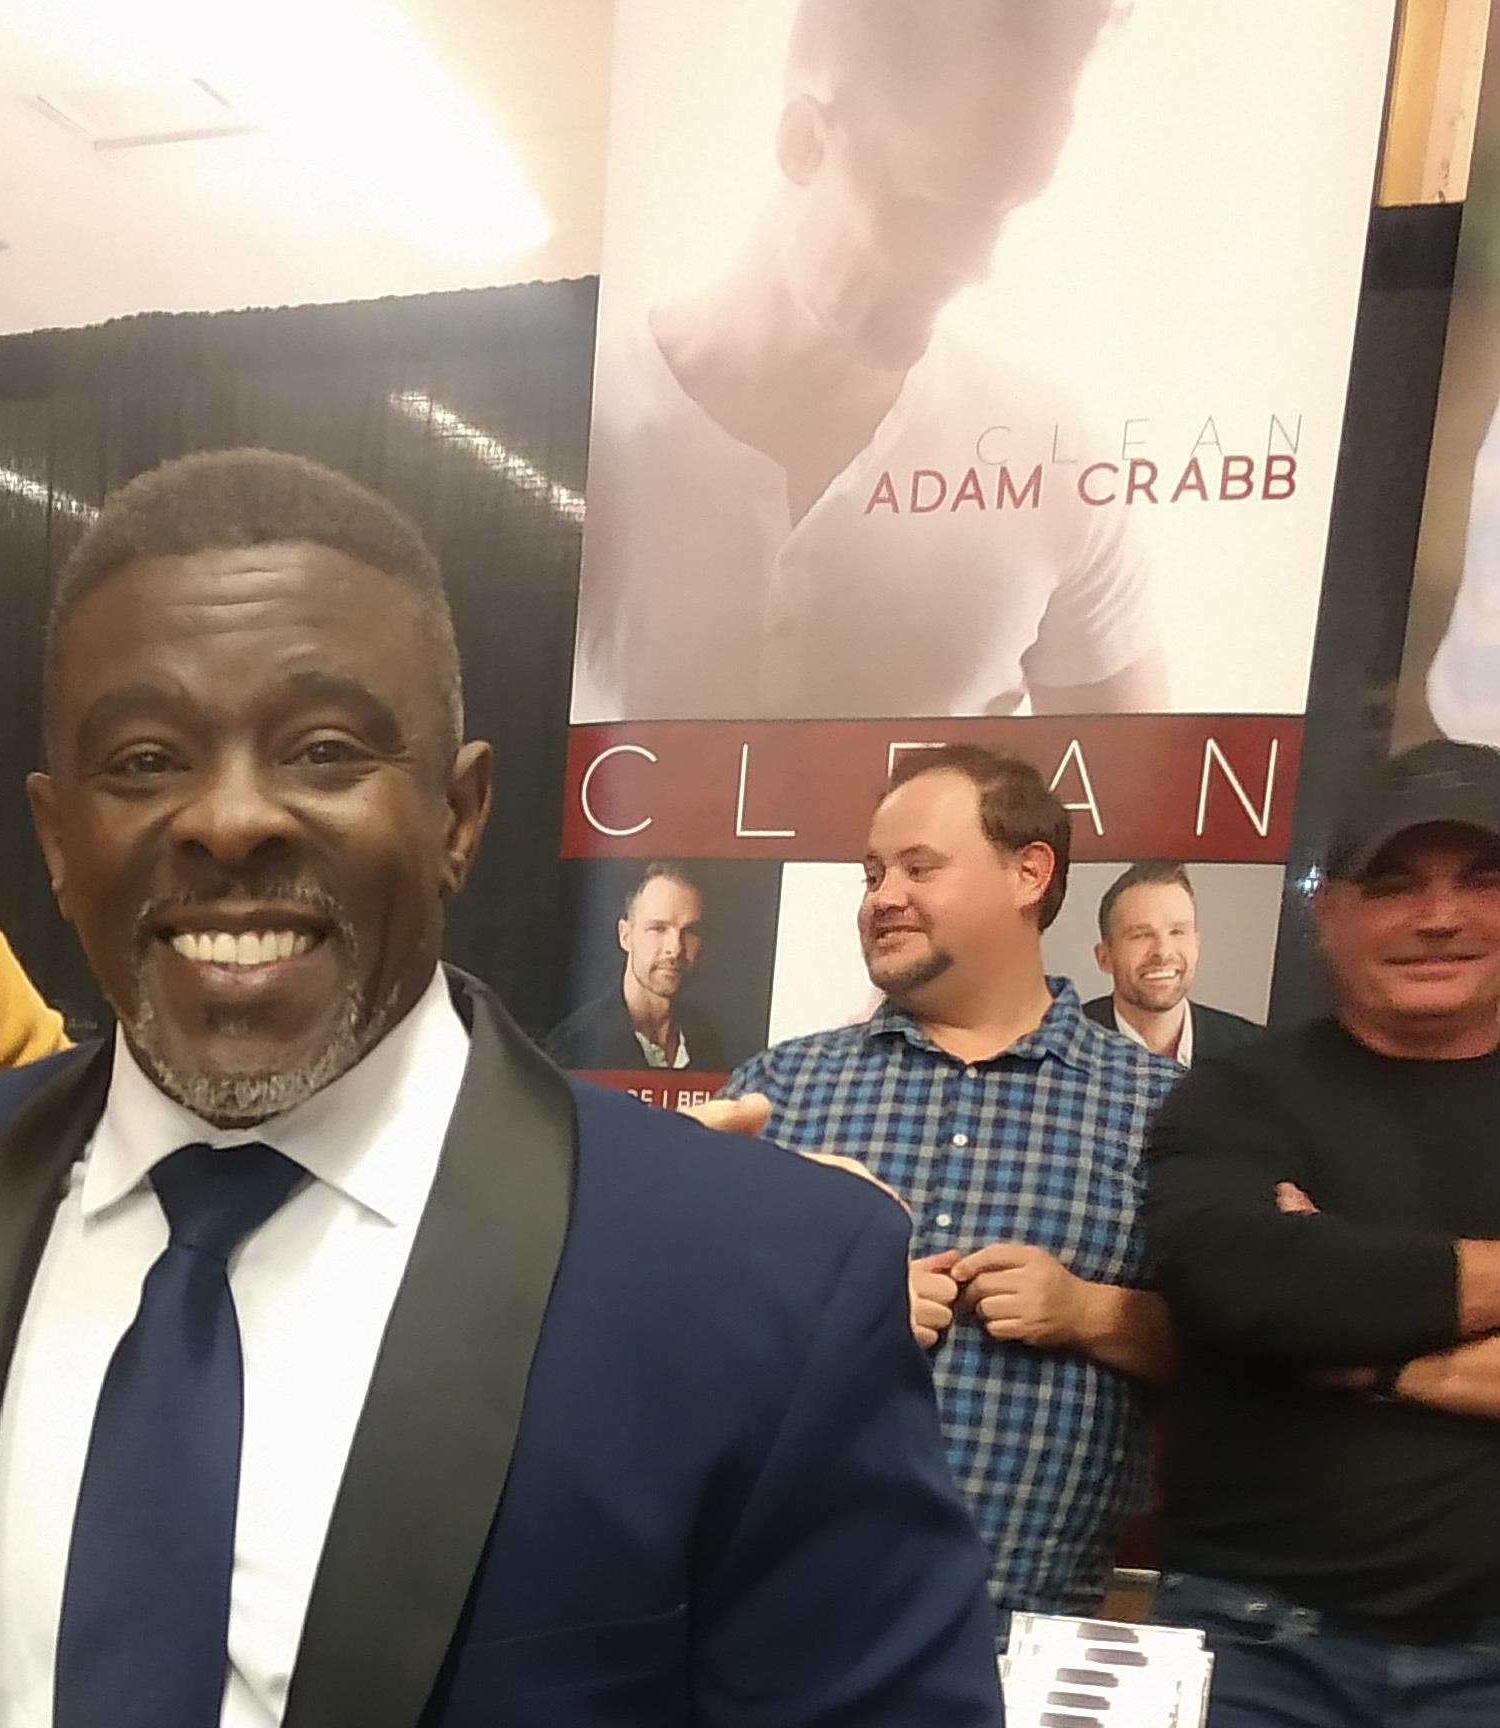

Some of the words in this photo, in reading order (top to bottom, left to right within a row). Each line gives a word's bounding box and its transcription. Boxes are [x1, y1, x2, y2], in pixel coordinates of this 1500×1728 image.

[975, 413, 1303, 466] CLEAN
[863, 463, 1043, 515] ADAM
[1077, 454, 1298, 507] CRABB
